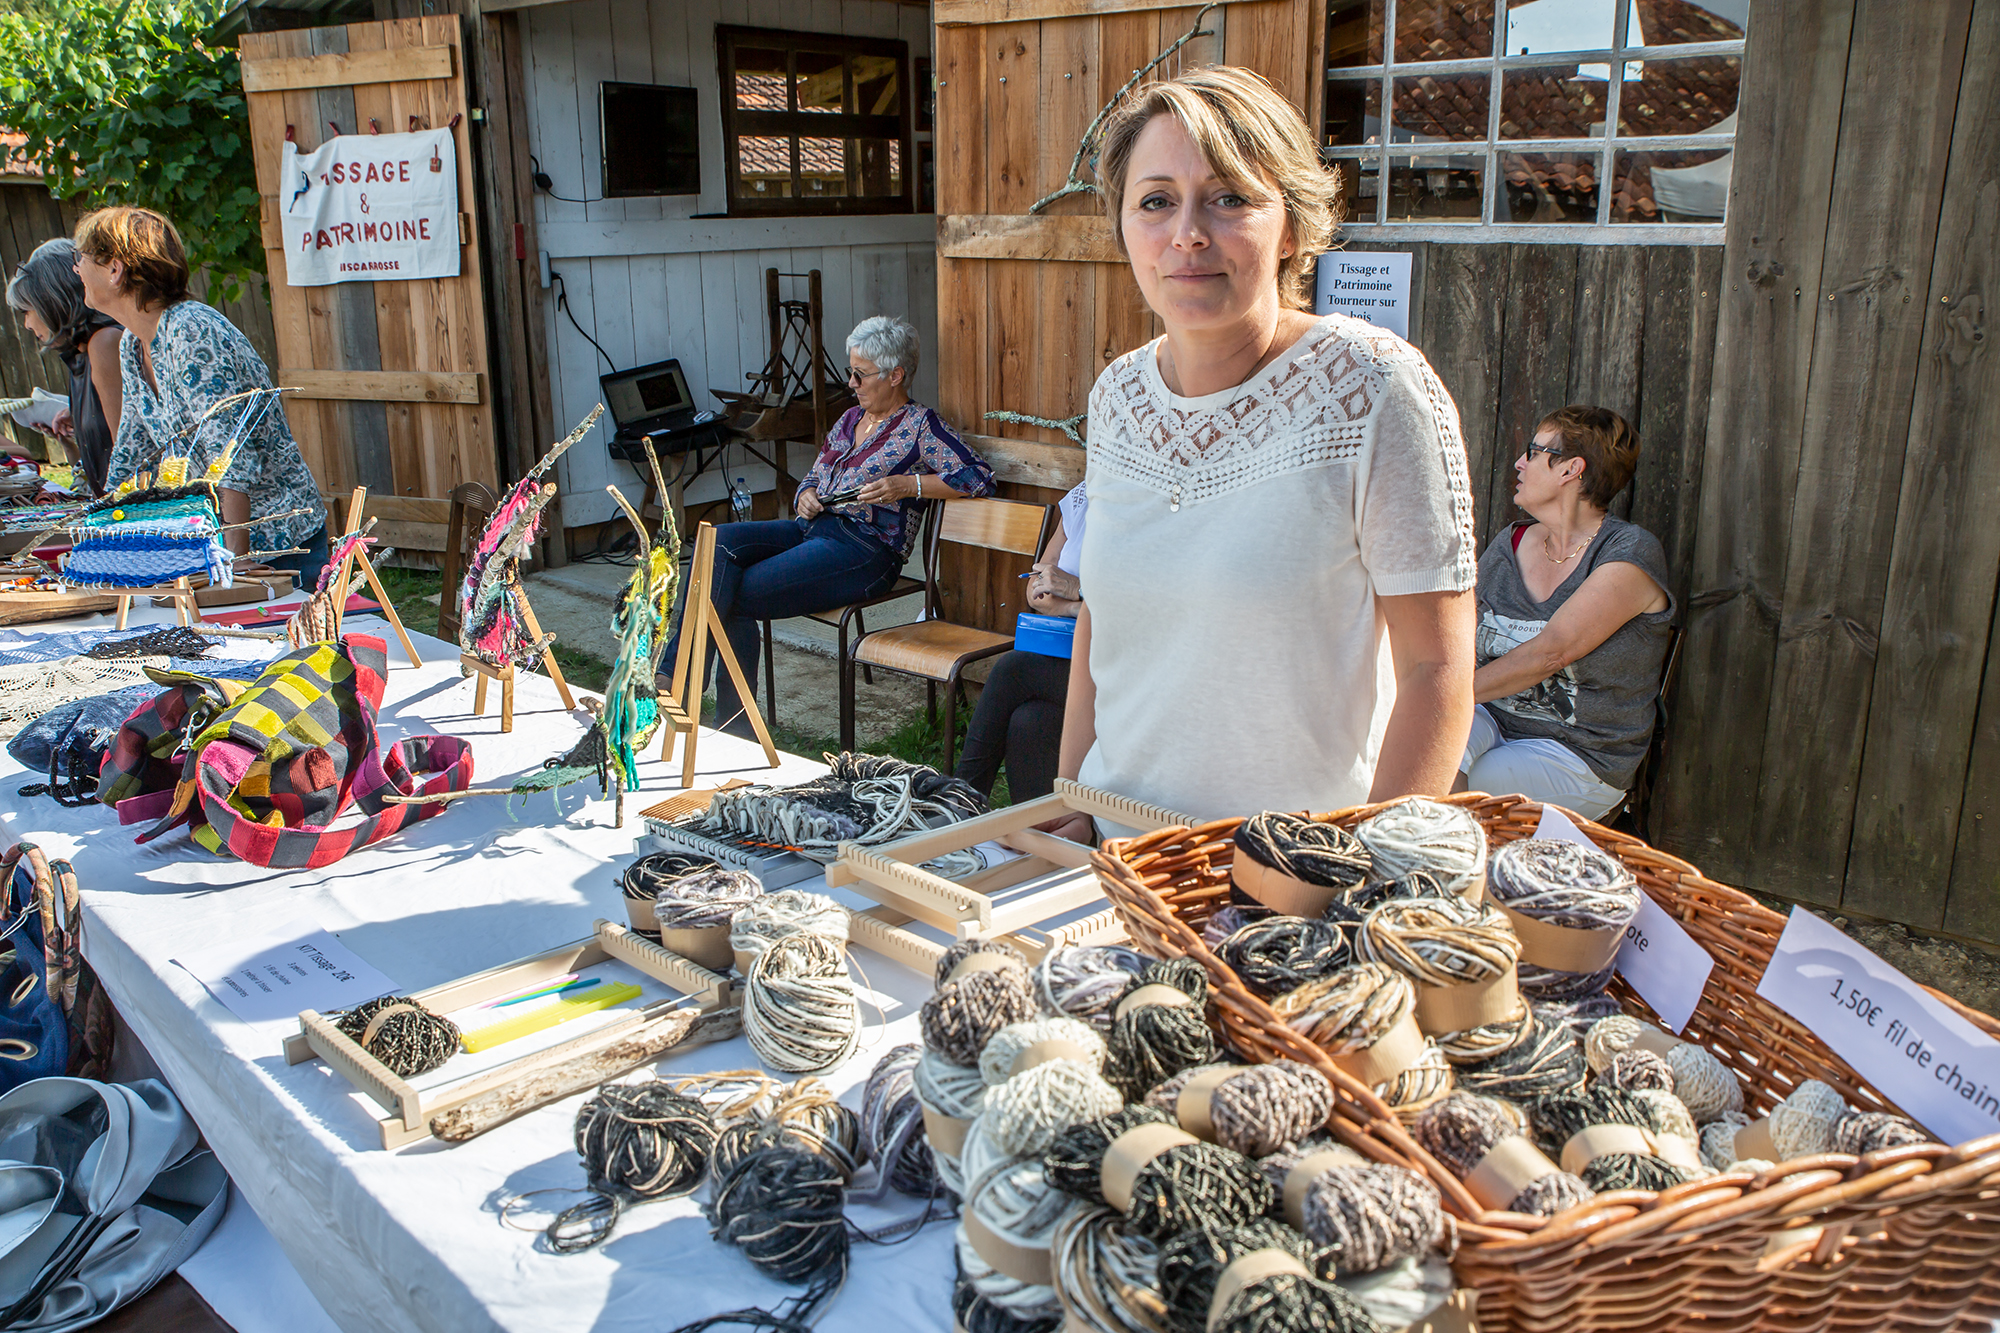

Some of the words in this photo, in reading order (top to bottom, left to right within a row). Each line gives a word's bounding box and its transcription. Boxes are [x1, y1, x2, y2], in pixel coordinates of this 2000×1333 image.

[360, 193, 370, 215] &
[302, 218, 431, 252] PATRIMOINE
[1339, 263, 1377, 277] Tissage
[1380, 265, 1390, 275] et
[1334, 279, 1392, 291] Patrimoine
[1327, 294, 1377, 306] Tourneur
[1379, 298, 1397, 307] sur
[1626, 925, 1649, 952] ote
[295, 944, 317, 953] KIT
[308, 951, 336, 970] Tissage
[332, 970, 355, 982] 20€
[1830, 978, 1883, 1027] 1,50€
[1884, 1019, 1908, 1047] fil
[1905, 1040, 1932, 1068] de
[1935, 1063, 2000, 1122] chain
